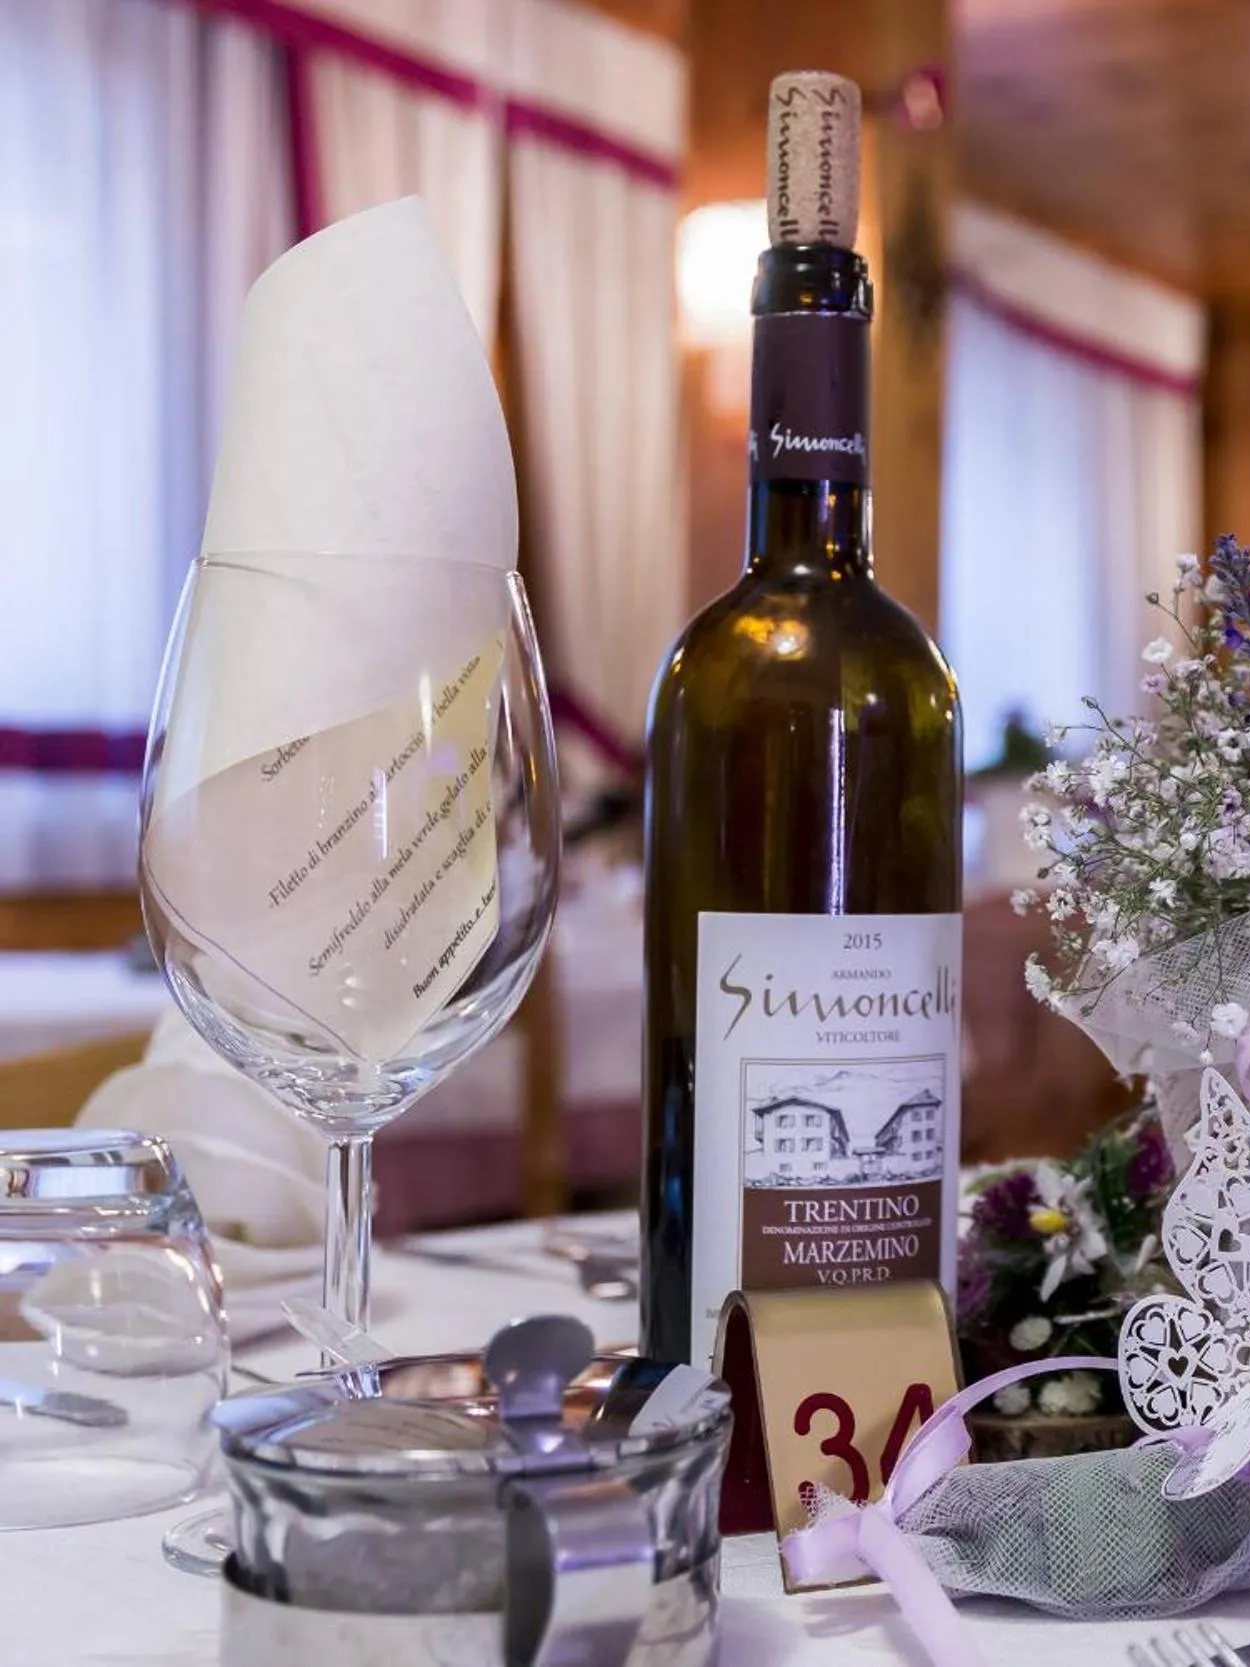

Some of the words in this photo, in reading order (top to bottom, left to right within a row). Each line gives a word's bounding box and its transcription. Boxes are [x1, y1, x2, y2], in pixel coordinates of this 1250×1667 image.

[775, 86, 807, 242] Simoncell
[812, 88, 848, 242] Simoncell
[268, 866, 309, 907] Filetto
[308, 849, 321, 870] di
[316, 801, 368, 856] branzino
[382, 732, 425, 784] artoccio
[308, 901, 371, 978] Semifreddo
[371, 878, 390, 903] alla
[388, 847, 413, 878] mela
[468, 748, 487, 775] alla
[384, 881, 435, 950] disidratata
[435, 869, 443, 881] e
[843, 933, 883, 950] 2015
[412, 965, 439, 999] Buon
[438, 918, 474, 969] appetito
[830, 969, 892, 981] ARMANDO
[816, 1030, 902, 1044] VITICOLTORE
[784, 1194, 920, 1223] TRENTINO
[783, 1234, 920, 1265] MARZEMINO
